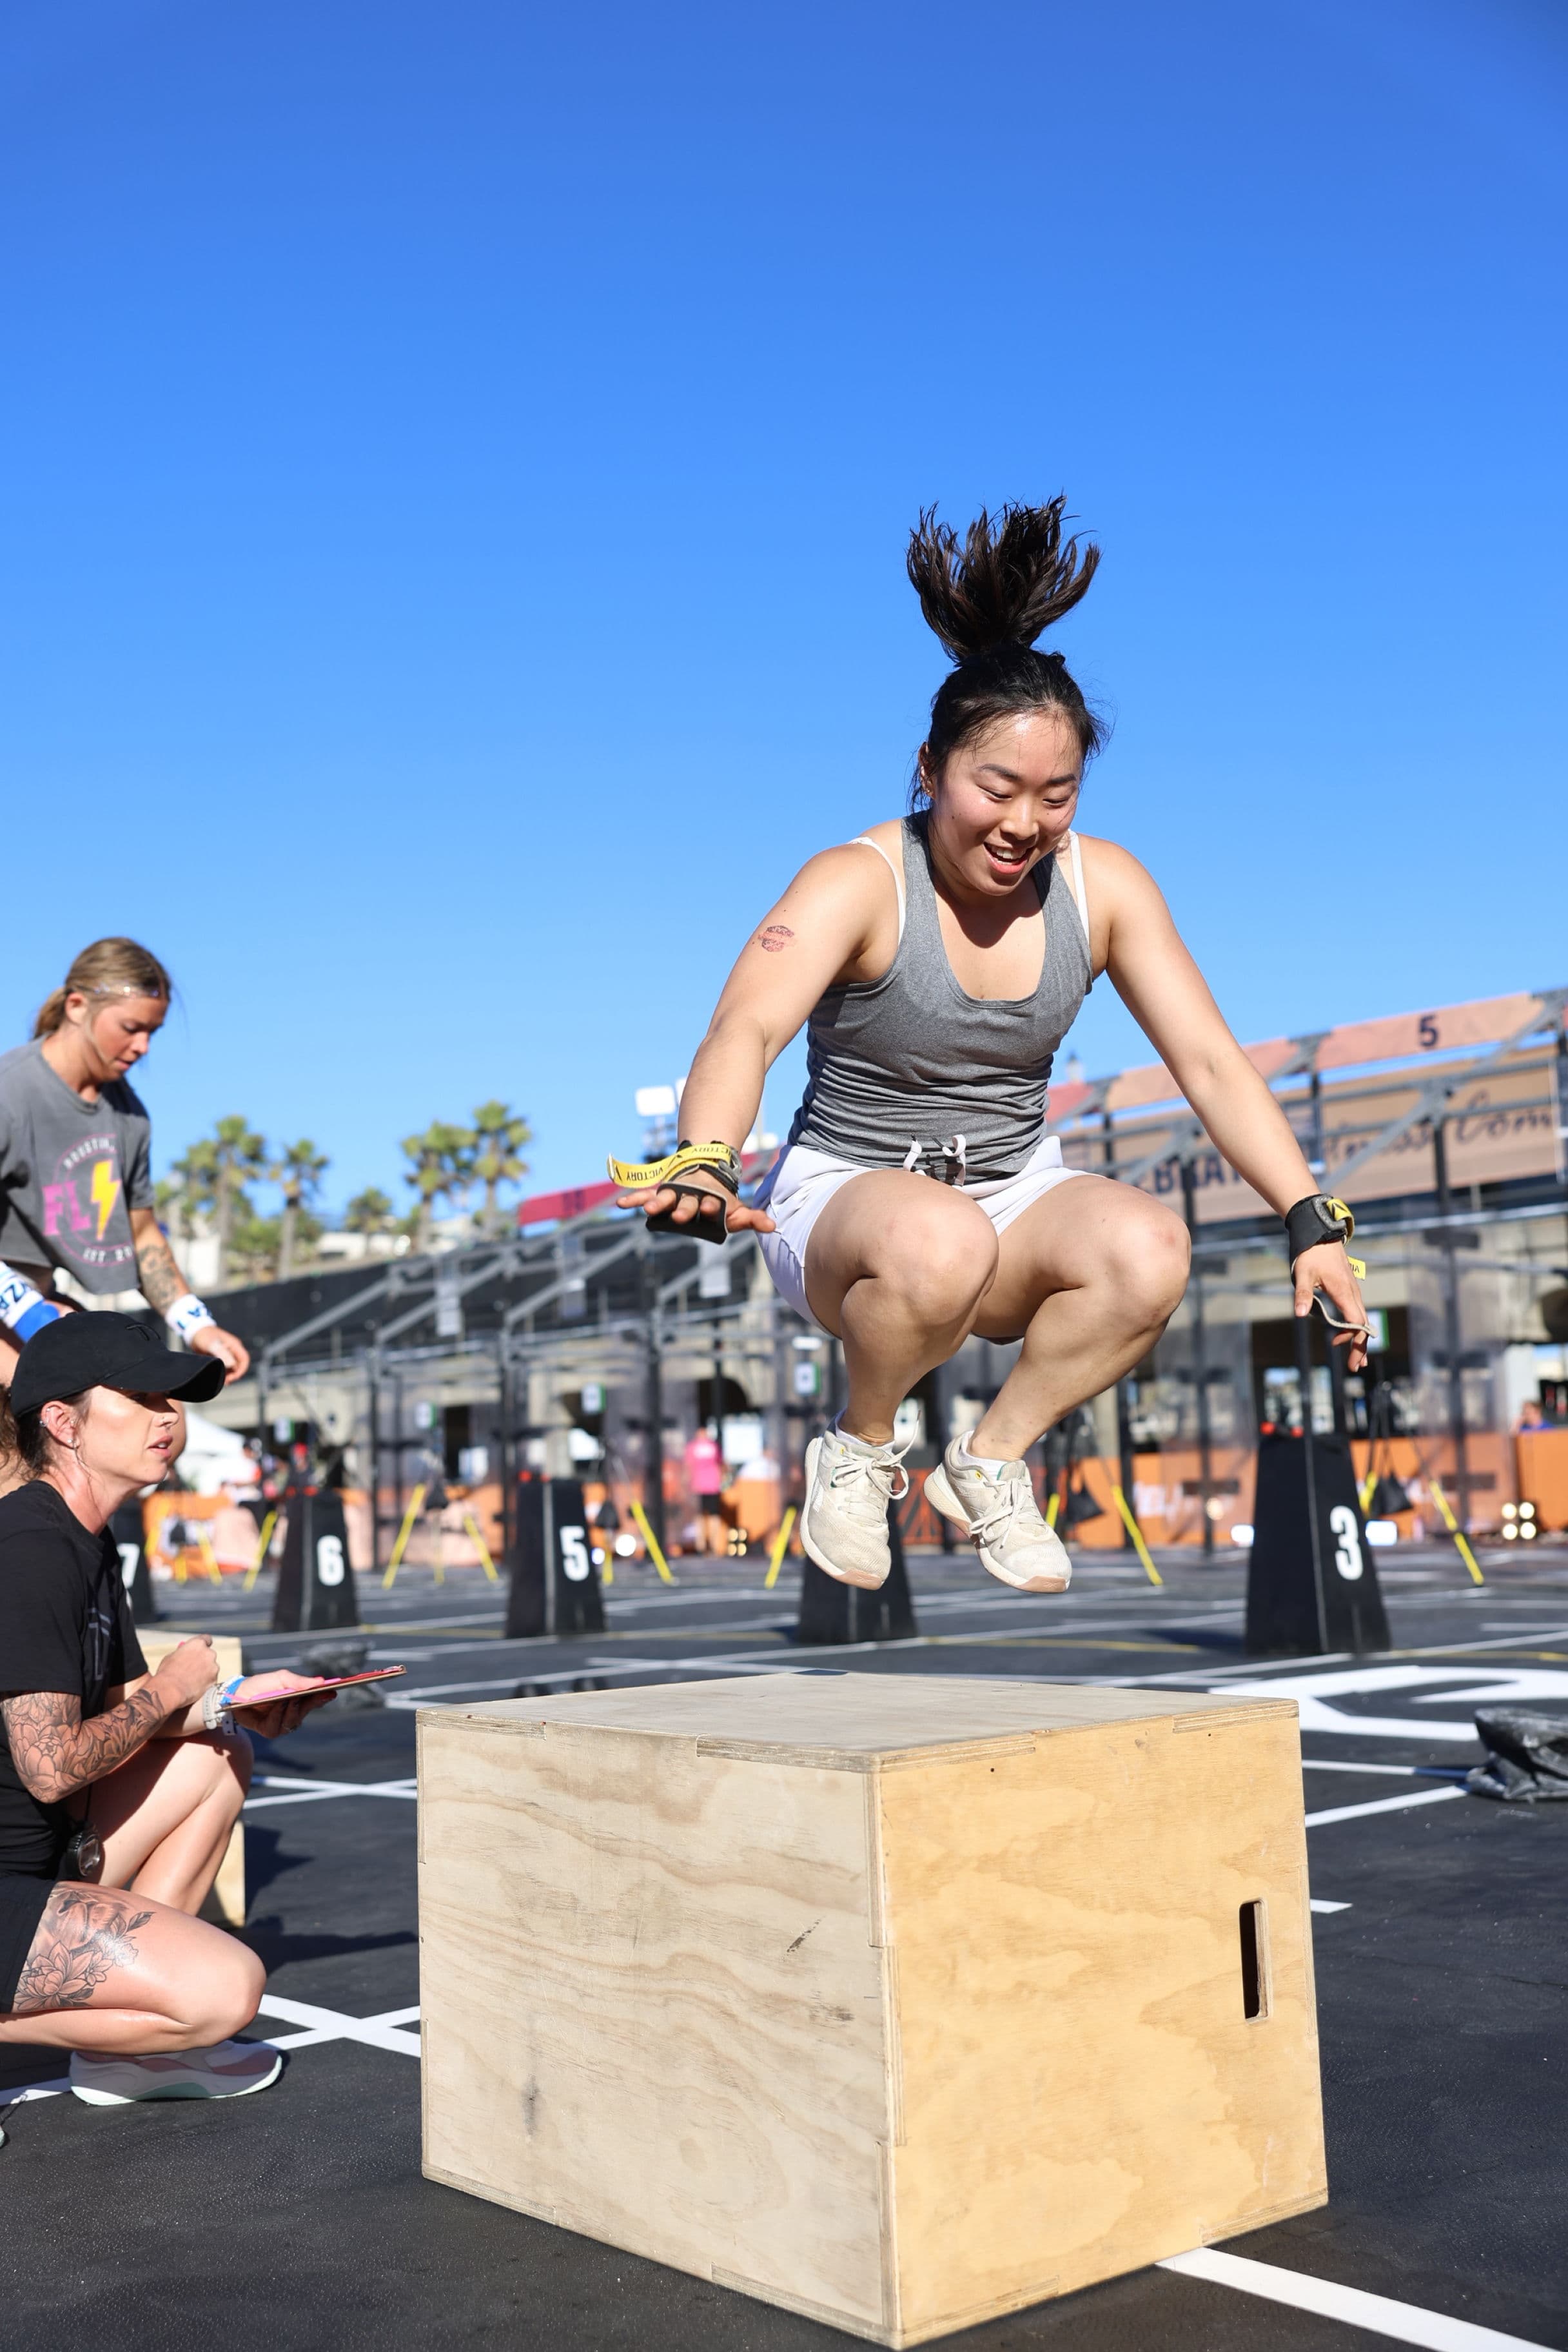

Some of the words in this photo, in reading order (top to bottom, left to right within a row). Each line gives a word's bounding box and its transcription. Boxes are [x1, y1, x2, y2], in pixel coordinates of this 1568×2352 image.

[1419, 1014, 1439, 1048] 5
[626, 1166, 663, 1182] VICTORY
[116, 1543, 140, 1589] 7
[317, 1535, 345, 1587] 6
[560, 1525, 589, 1582] 5
[1329, 1505, 1364, 1580] 3
